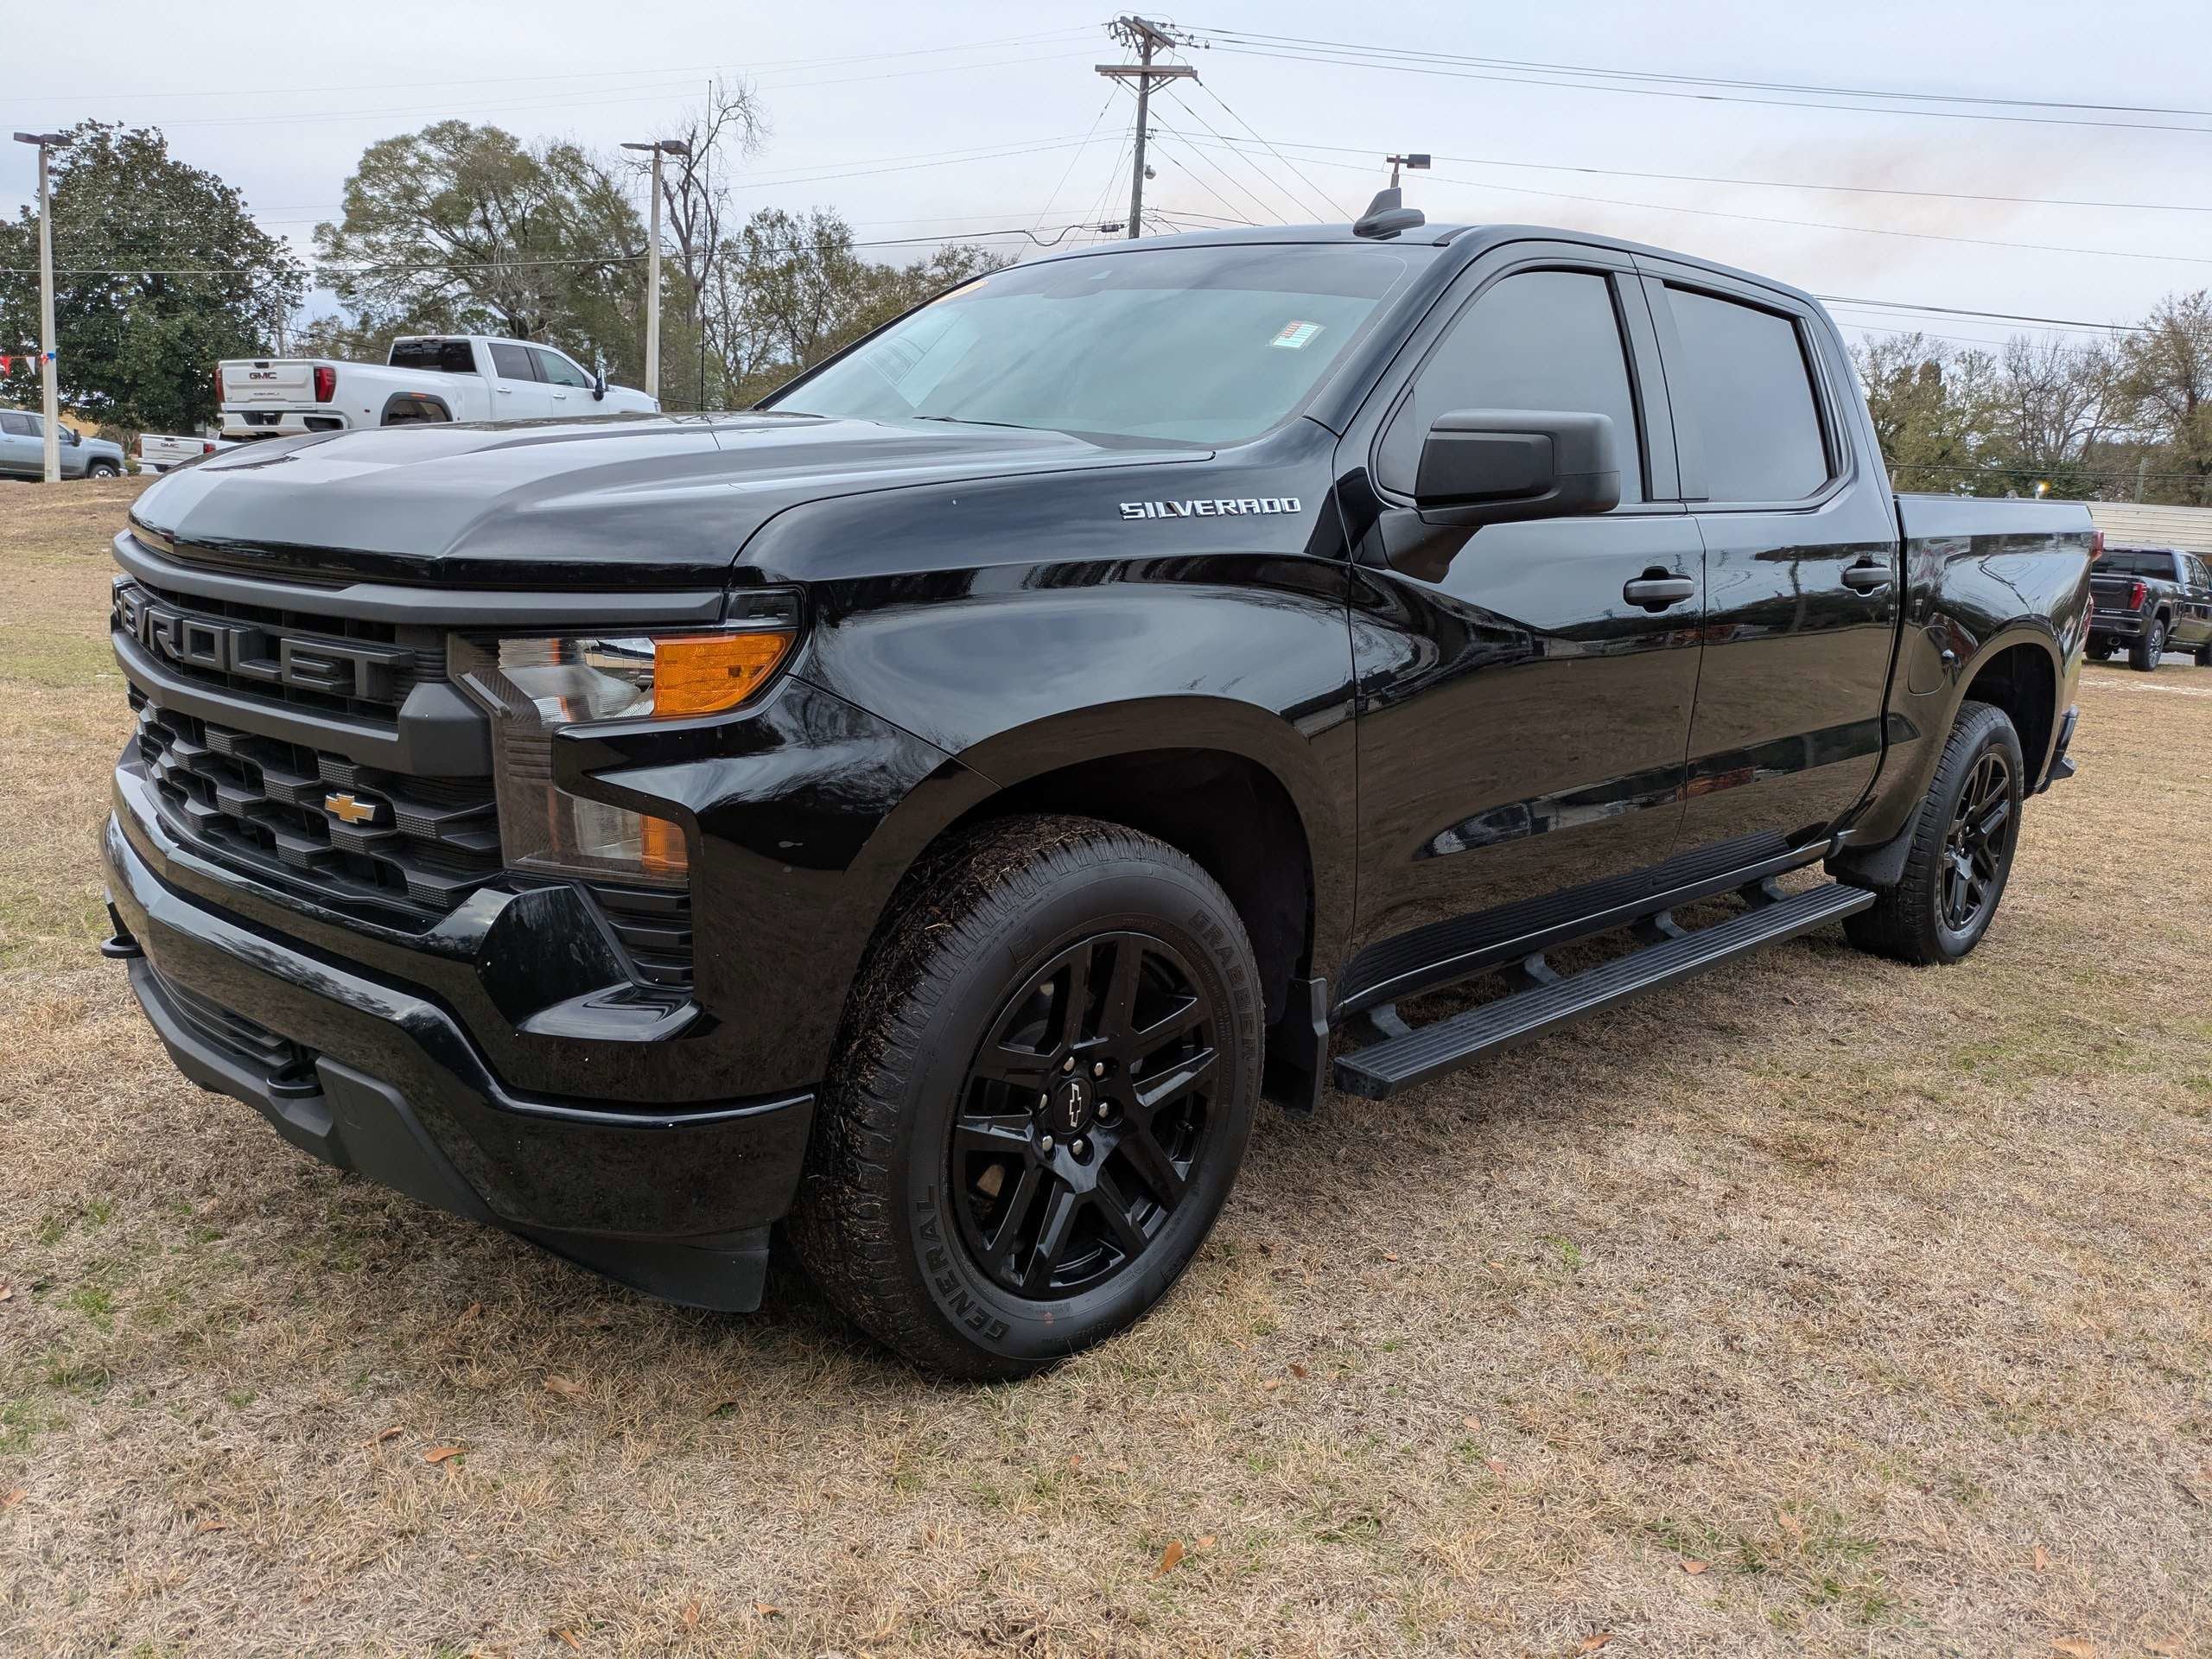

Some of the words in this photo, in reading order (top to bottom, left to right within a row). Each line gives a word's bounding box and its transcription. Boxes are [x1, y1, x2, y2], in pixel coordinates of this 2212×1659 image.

[249, 372, 277, 380] GMC
[1119, 497, 1301, 519] SILVERADO
[111, 575, 415, 698] HEVROLET
[1188, 908, 1256, 1061] GRABBER
[915, 1185, 1011, 1344] GENERAL
